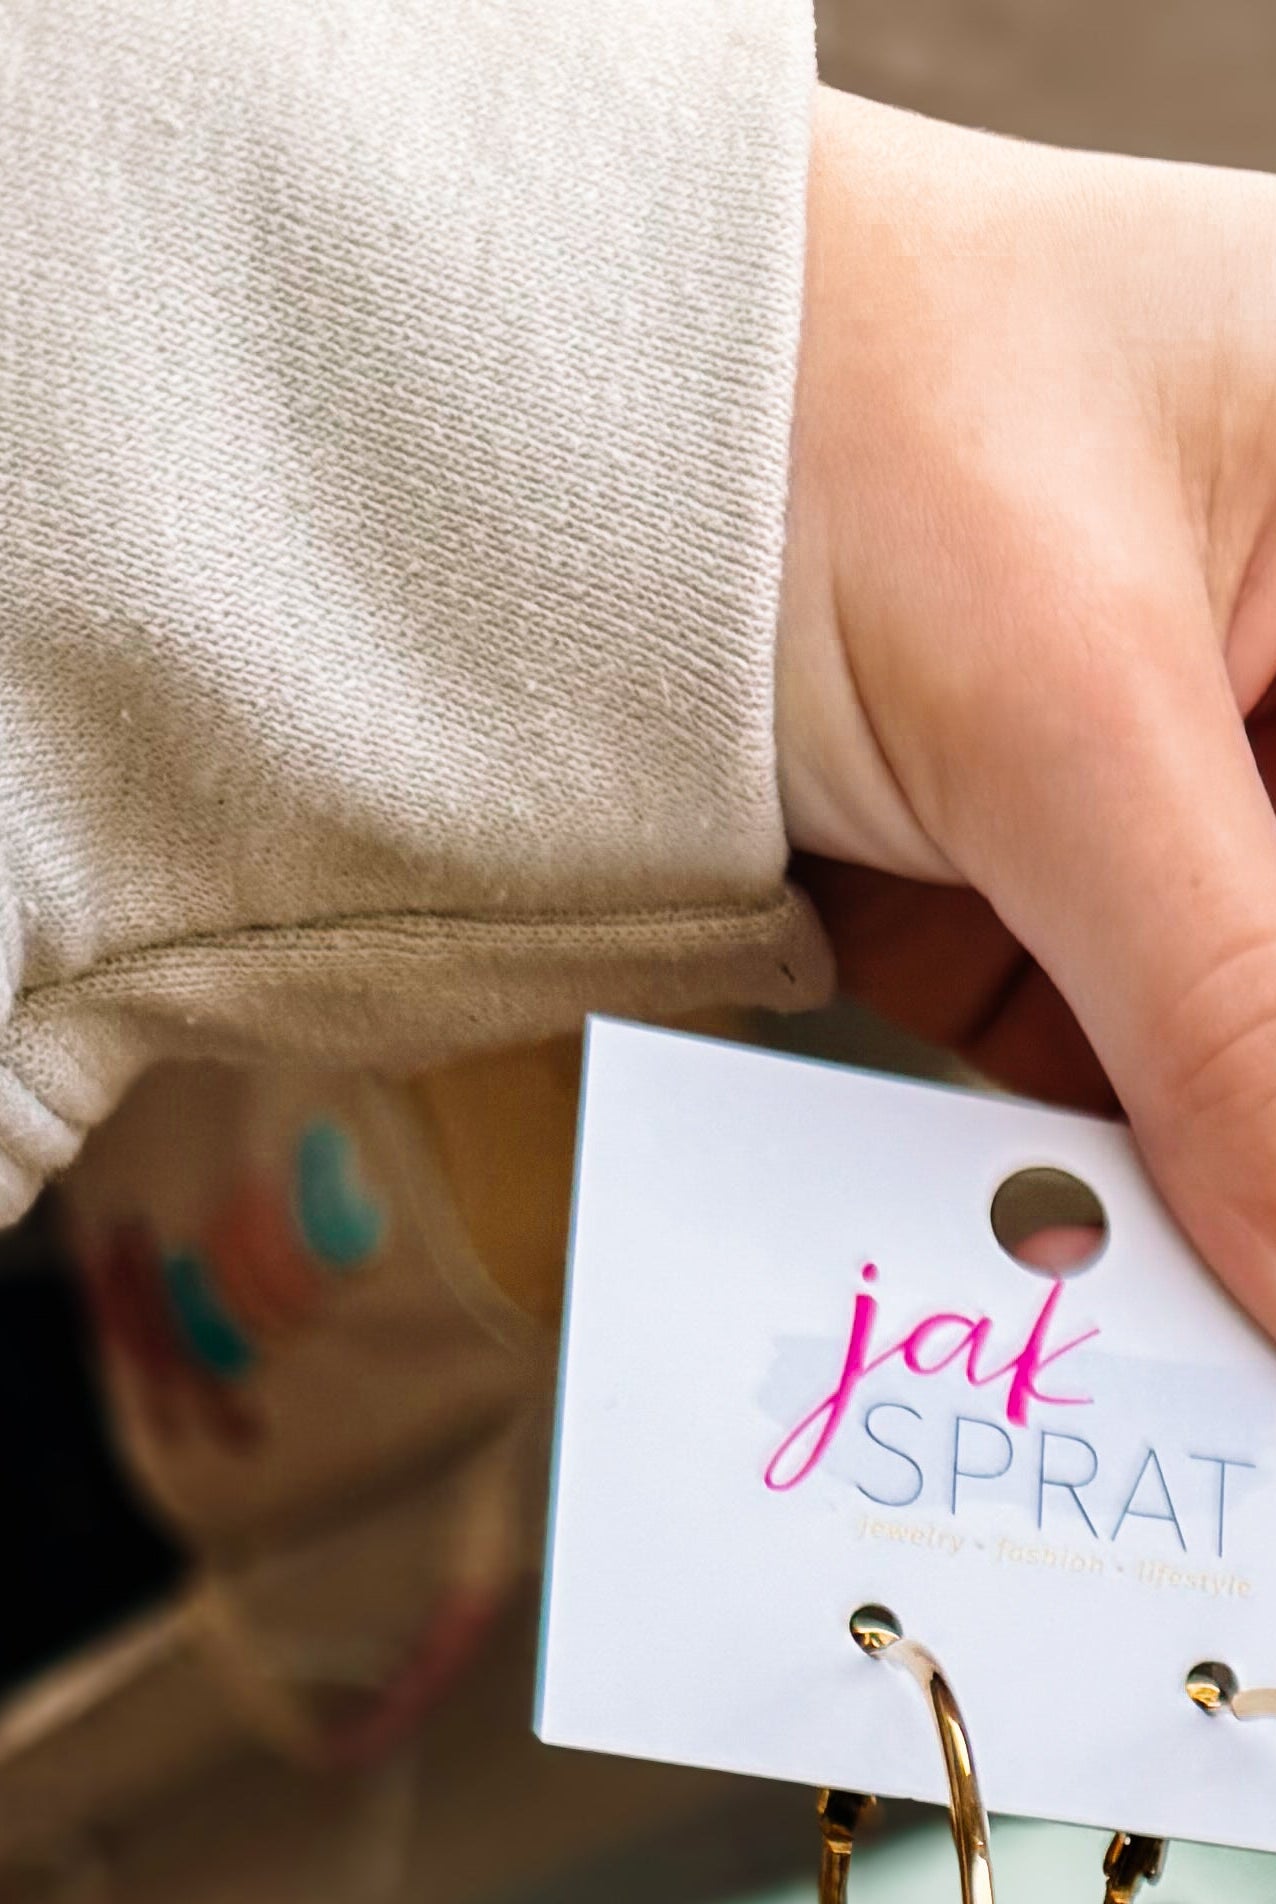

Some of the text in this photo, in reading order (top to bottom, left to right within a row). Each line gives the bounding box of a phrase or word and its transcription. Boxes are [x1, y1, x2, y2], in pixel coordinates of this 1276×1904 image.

[763, 1262, 1101, 1492] jak
[854, 1401, 1258, 1558] SPRAT
[856, 1512, 1253, 1599] jewelry fashion lifestyle
